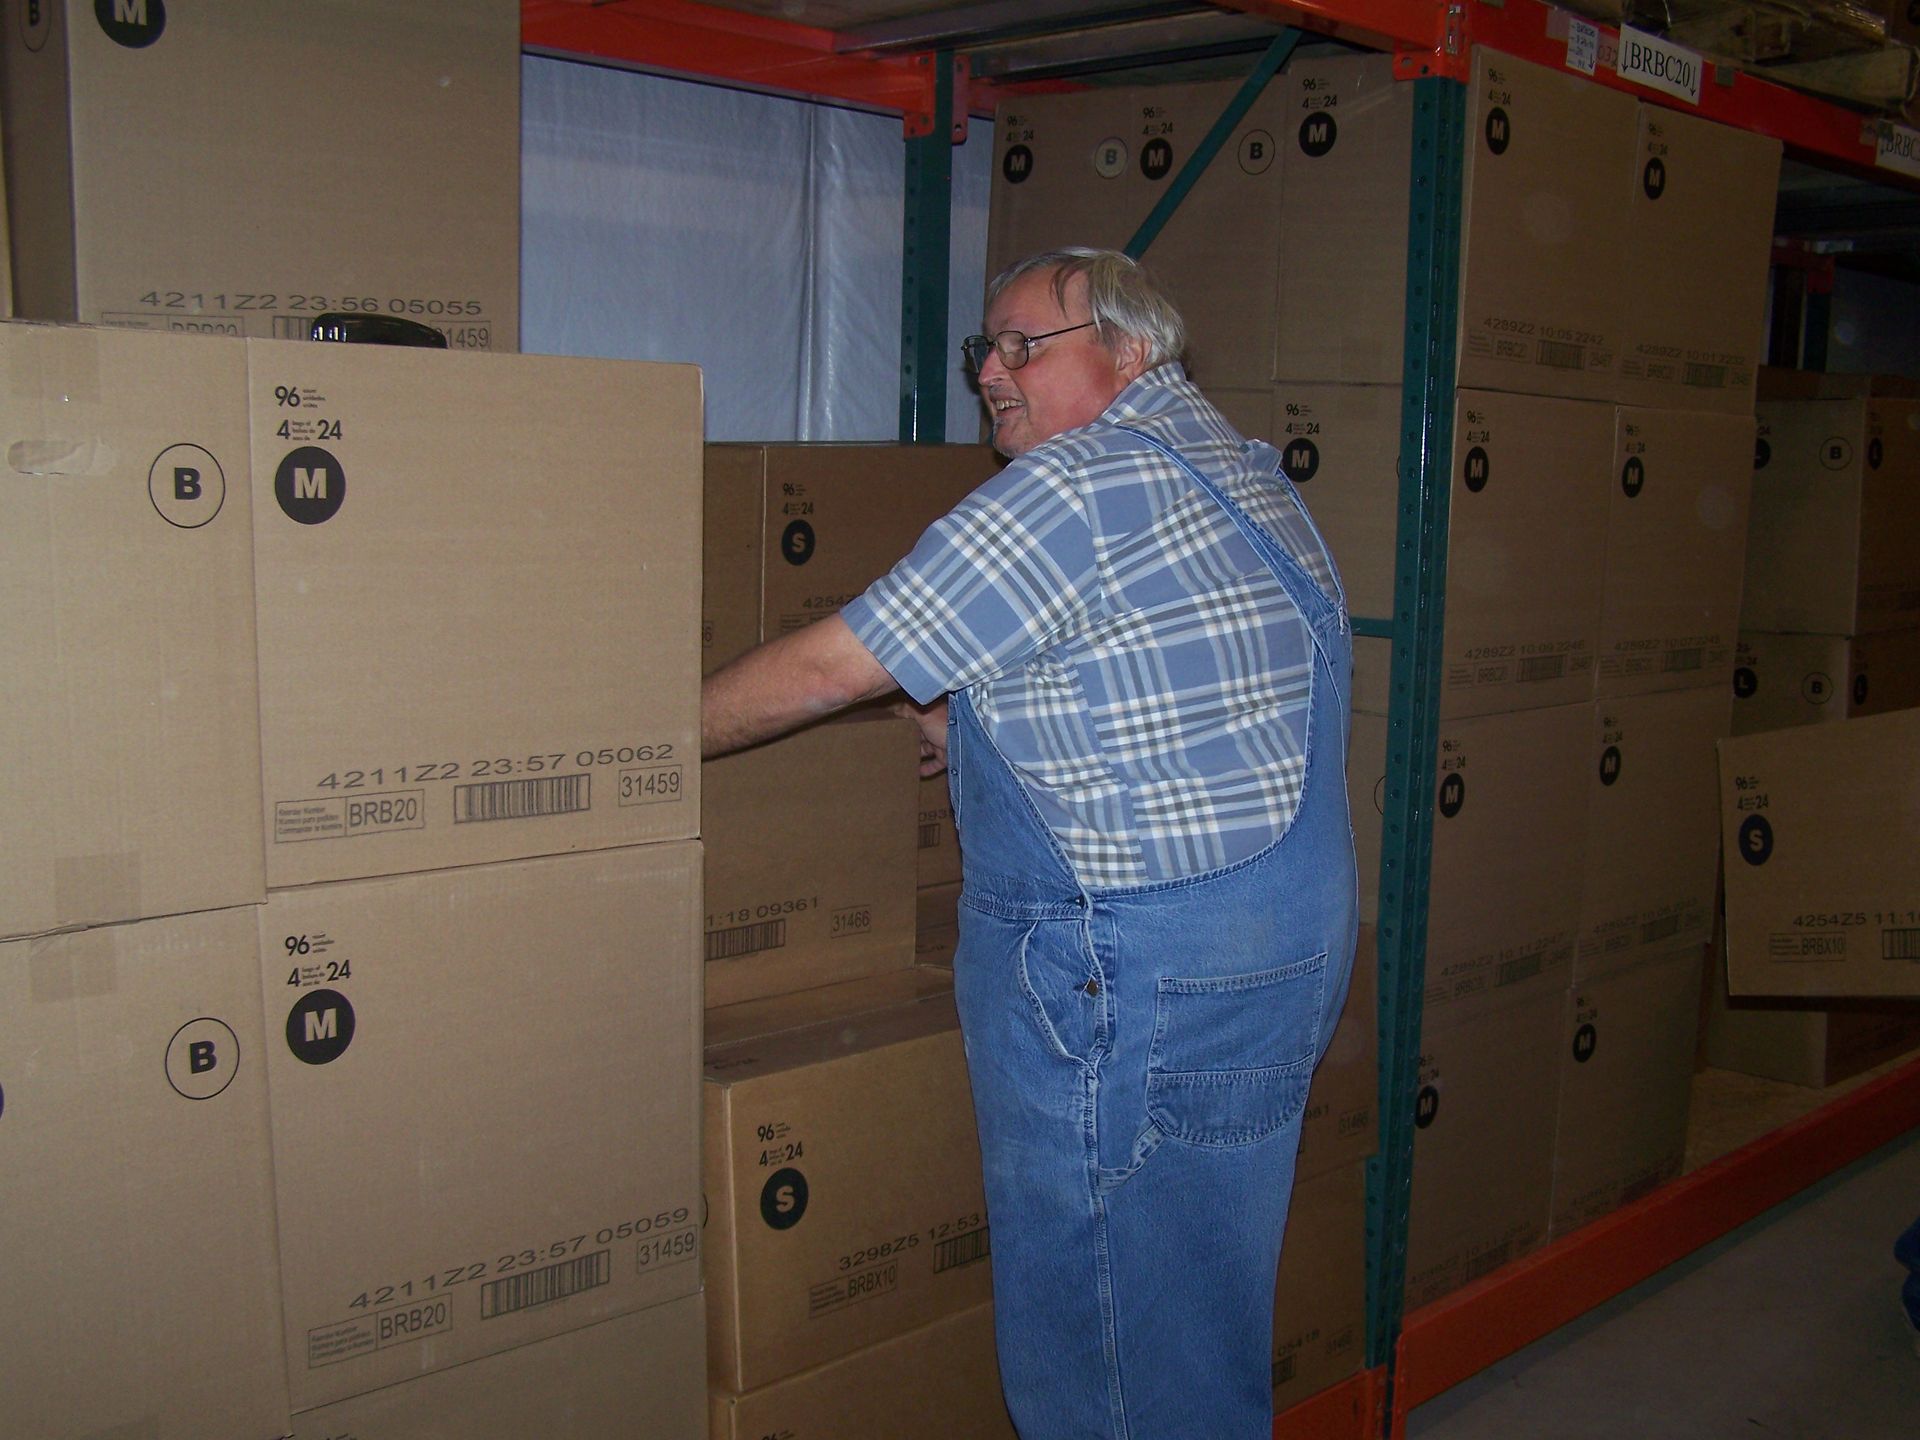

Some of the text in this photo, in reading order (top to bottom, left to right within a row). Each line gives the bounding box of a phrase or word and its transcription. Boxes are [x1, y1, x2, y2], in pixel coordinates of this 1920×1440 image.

[113, 0, 148, 26] M
[1630, 42, 1691, 88] BRBC20
[1302, 79, 1316, 91] 96
[1324, 95, 1337, 108] 24
[1307, 123, 1327, 144] M
[1492, 118, 1504, 140] M
[1105, 148, 1117, 165] B
[1148, 148, 1164, 169] M
[1250, 142, 1263, 160] B
[1010, 155, 1026, 172] M
[1649, 168, 1660, 188] M
[139, 291, 484, 316] 4211Z2 23:56 05055
[443, 327, 490, 348] 1459
[275, 386, 301, 407] 96
[1286, 404, 1300, 416] 96
[277, 420, 292, 440] 4
[317, 419, 343, 440] 24
[1306, 423, 1320, 435] 24
[1291, 449, 1310, 469] M
[1471, 458, 1483, 479] M
[173, 467, 201, 500] B
[293, 467, 328, 500] M
[1628, 466, 1639, 485] M
[791, 531, 806, 554] S
[316, 744, 674, 790] 4211Z2 23:57 05062
[1605, 756, 1616, 774] M
[621, 771, 681, 800] 31459
[1445, 784, 1458, 805] M
[349, 797, 418, 829] BRB20
[1748, 828, 1764, 854] S
[756, 895, 819, 918] 09361
[832, 910, 870, 933] 31466
[1792, 912, 1866, 927] 4254Z5
[285, 934, 310, 956] 96
[287, 967, 302, 987] 4
[326, 958, 352, 982] 24
[304, 1007, 338, 1042] M
[1579, 1033, 1591, 1052] M
[189, 1040, 217, 1075] B
[1420, 1096, 1432, 1116] M
[757, 1124, 775, 1142] 96
[759, 1150, 769, 1167] 4
[785, 1141, 804, 1161] 24
[775, 1185, 795, 1213] S
[639, 1230, 696, 1266] 31459
[838, 1213, 980, 1271] 3298Z5 12:53
[348, 1207, 690, 1309] 4211Z2 23:57 05059
[847, 1264, 896, 1299] BRBX10
[379, 1302, 446, 1341] BRB20
